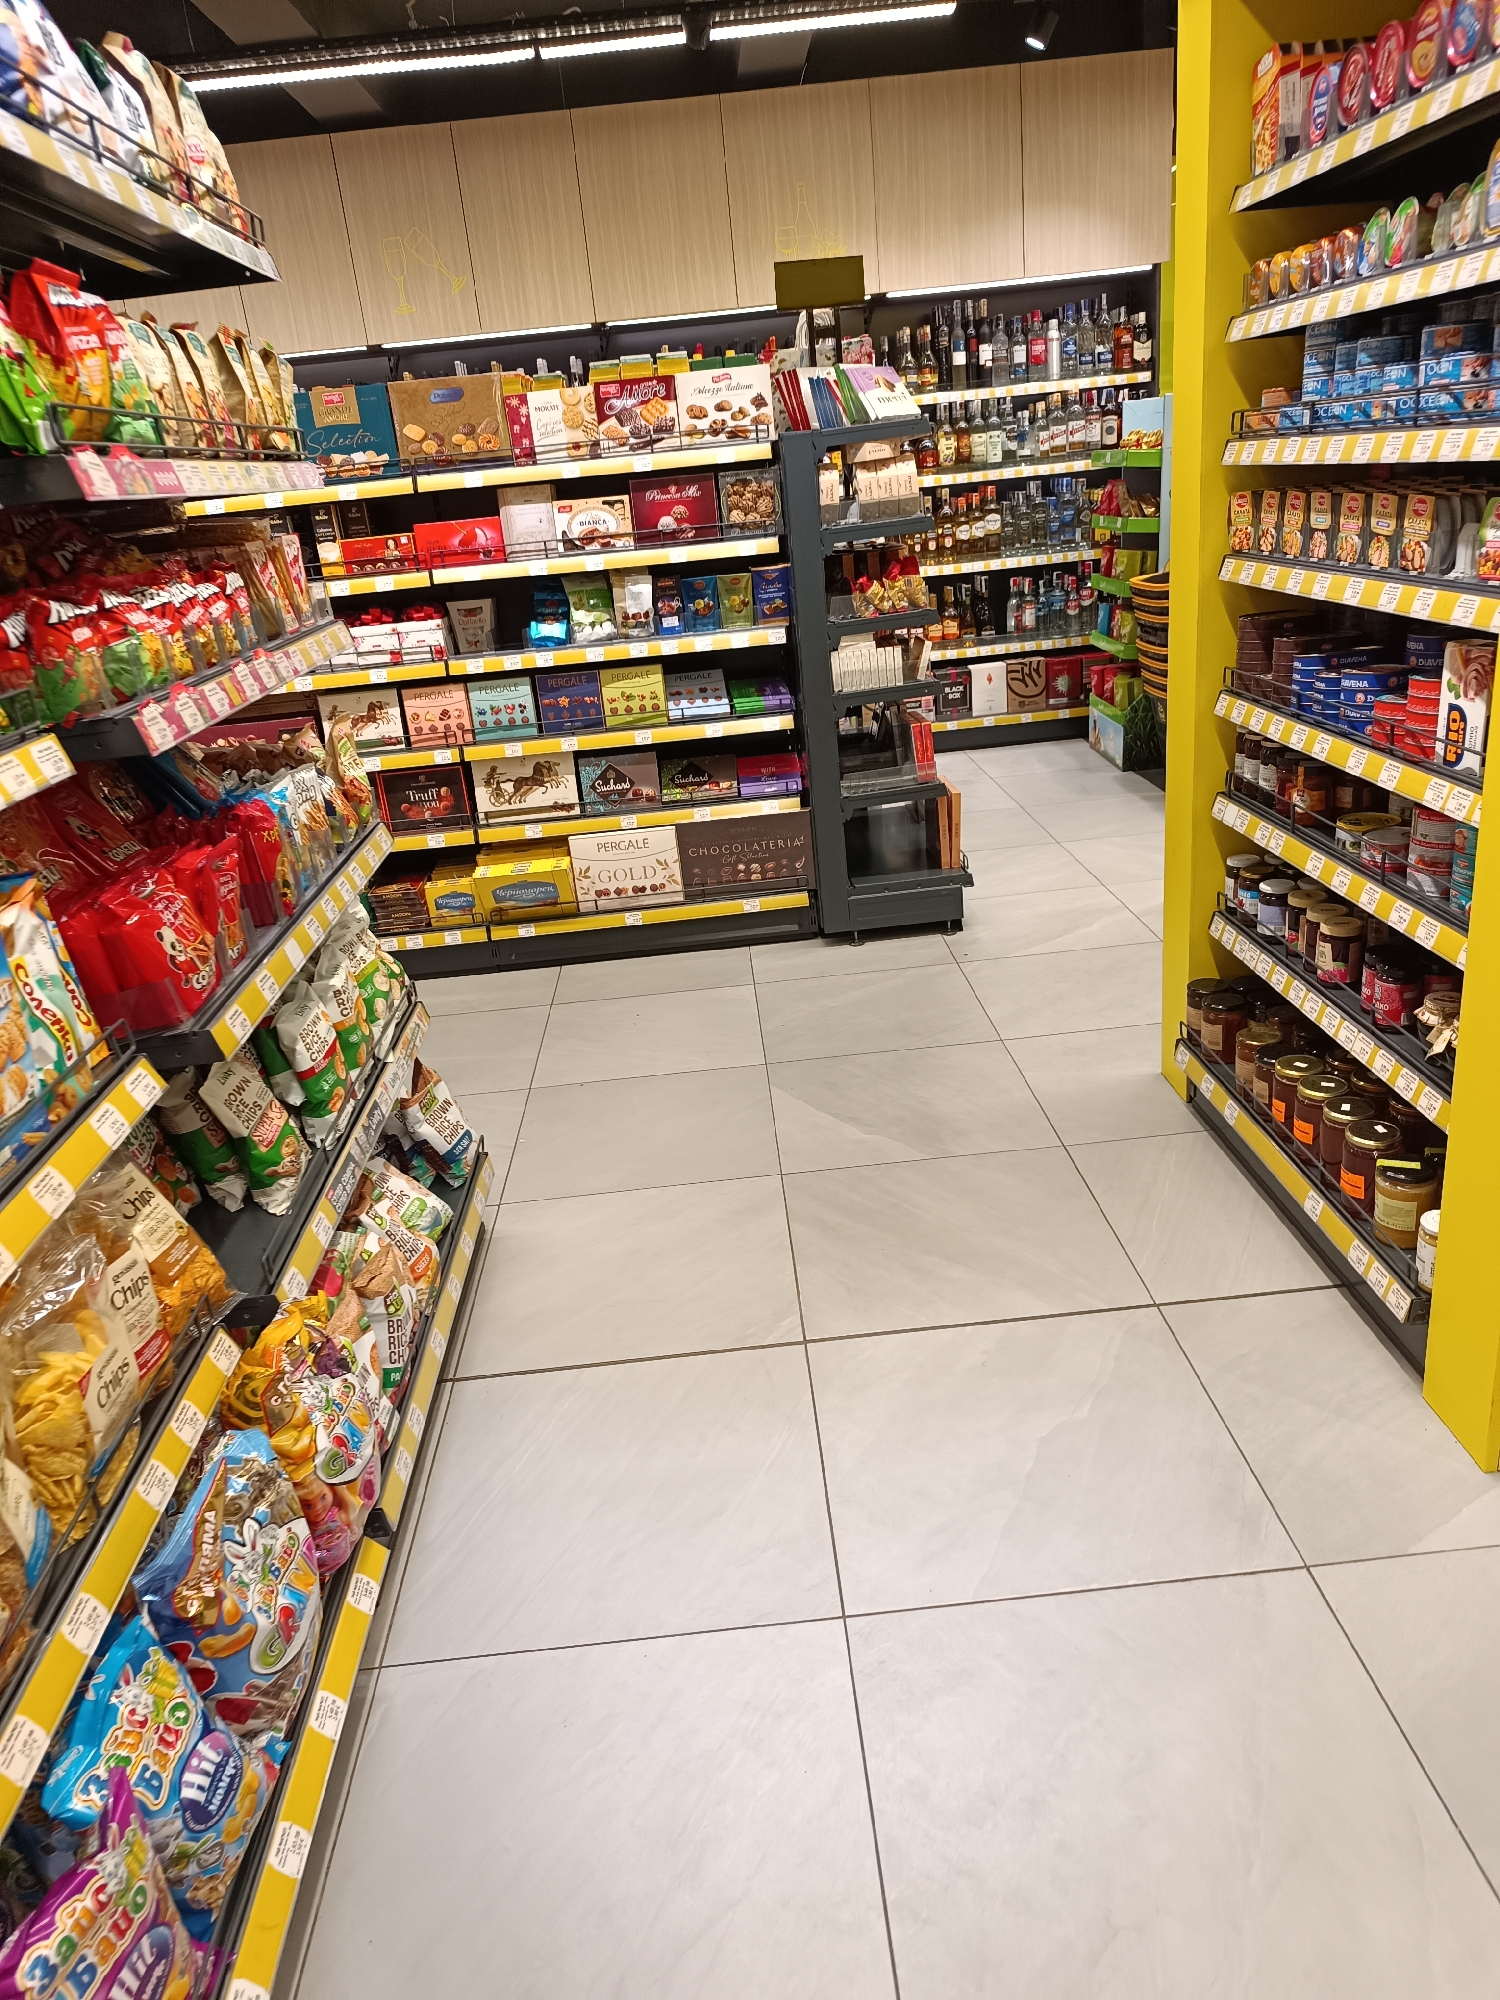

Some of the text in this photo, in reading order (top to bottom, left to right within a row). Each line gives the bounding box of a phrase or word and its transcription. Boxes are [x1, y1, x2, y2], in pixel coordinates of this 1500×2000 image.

[186, 142, 207, 154] XXL
[876, 392, 908, 404] merci
[307, 428, 382, 457] Selection
[579, 519, 607, 527] BIANCA
[457, 616, 487, 627] Raffaello
[547, 675, 588, 688] PERGALE
[611, 670, 651, 682] PERGALE
[674, 671, 713, 682] PERGALE
[413, 689, 454, 701] PERGALE
[478, 682, 520, 695] PERGALE
[944, 684, 964, 694] BLACK
[948, 691, 962, 700] BOX
[594, 776, 631, 794] Suchard
[673, 773, 710, 785] Suchard
[405, 788, 439, 802] Truff
[422, 799, 440, 812] you
[596, 837, 650, 853] PERGALE
[597, 864, 658, 884] GOLD
[299, 1012, 323, 1044] BROWN
[304, 1029, 322, 1053] RICE
[309, 1036, 330, 1063] CHIPS
[223, 1076, 252, 1111] BROWN
[232, 1098, 250, 1121] RICE
[241, 1100, 264, 1130] CHIPS
[425, 1096, 453, 1129] BROWN
[252, 1112, 275, 1144] SUPER
[435, 1115, 456, 1139] RICE
[443, 1120, 466, 1147] CHIPS
[122, 1186, 156, 1221] Chips
[396, 1230, 413, 1254] RICE
[401, 1236, 424, 1262] CHIPS
[109, 1270, 151, 1312] Chips
[96, 1356, 131, 1409] Chips
[133, 1700, 192, 1803] Байо
[180, 1740, 224, 1806] Hit
[63, 1884, 148, 1999] Байо
